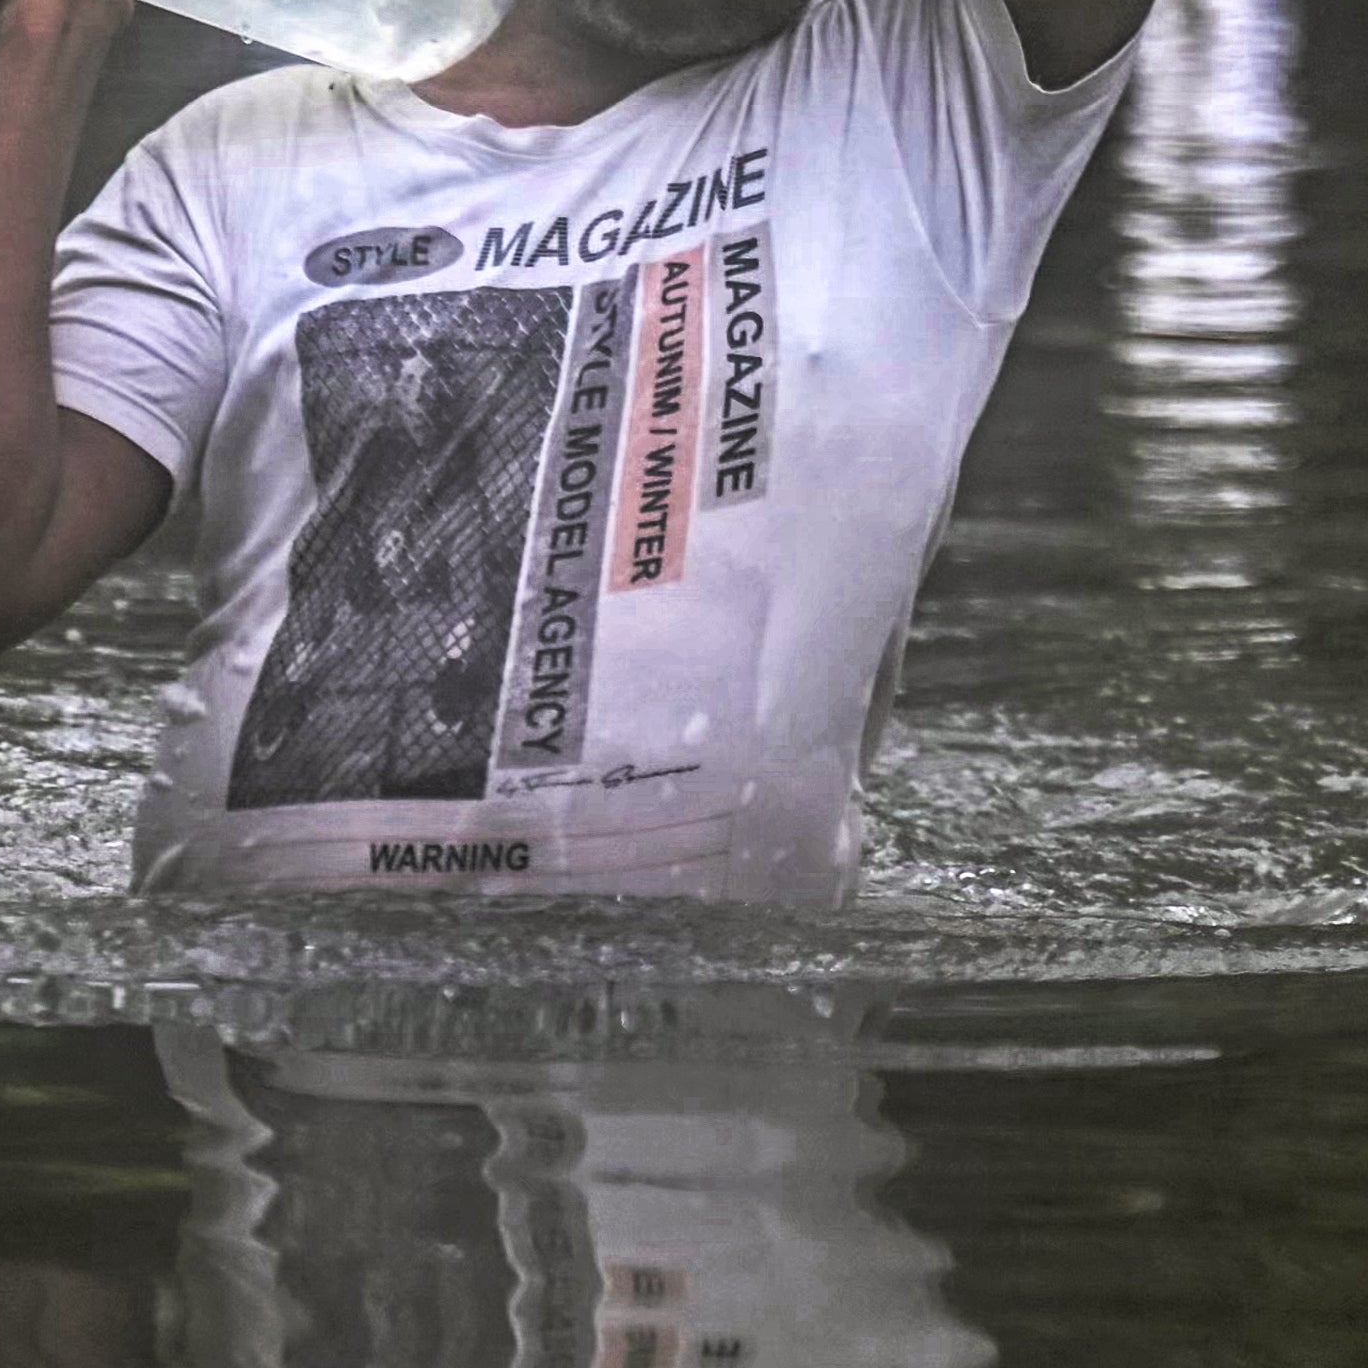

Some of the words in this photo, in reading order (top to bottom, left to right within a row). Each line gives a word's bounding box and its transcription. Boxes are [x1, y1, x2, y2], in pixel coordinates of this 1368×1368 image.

[332, 235, 432, 277] STYLE
[475, 147, 769, 271] MAGAZINE
[569, 288, 620, 415] STYLE
[715, 236, 765, 498] MAGAZINE
[546, 423, 603, 577] MODEL
[630, 443, 676, 585] WINTER
[521, 585, 580, 755] AGENCY
[369, 841, 531, 874] WARNING
